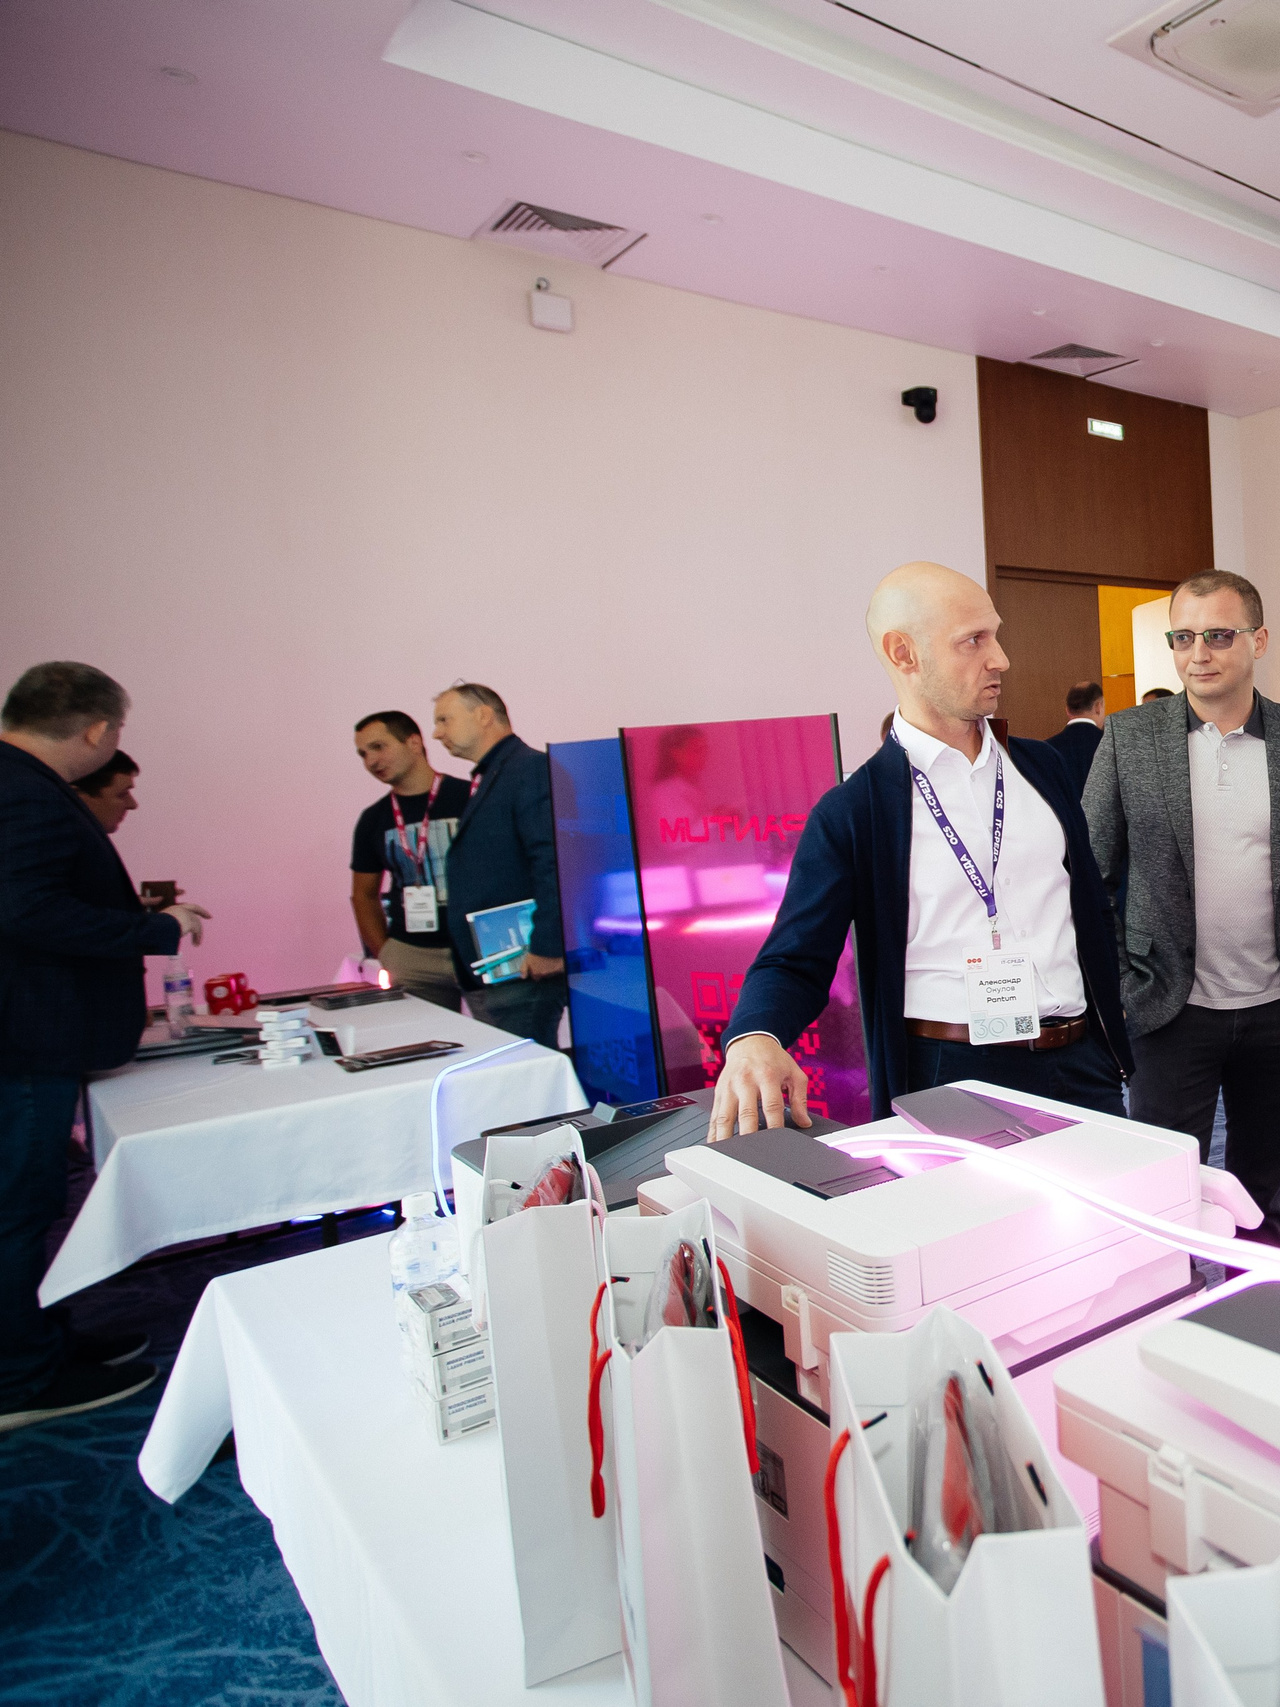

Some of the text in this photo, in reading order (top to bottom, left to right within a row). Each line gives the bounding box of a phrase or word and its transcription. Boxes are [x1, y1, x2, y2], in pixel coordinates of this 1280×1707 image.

[915, 773, 988, 898] IT-СРЕДА OCS IT-СРЕДА
[993, 818, 1002, 862] IT-СРЕДА
[979, 978, 1021, 986] Александр
[986, 986, 1015, 994] Окулов
[438, 1308, 472, 1322] MONOCHROM
